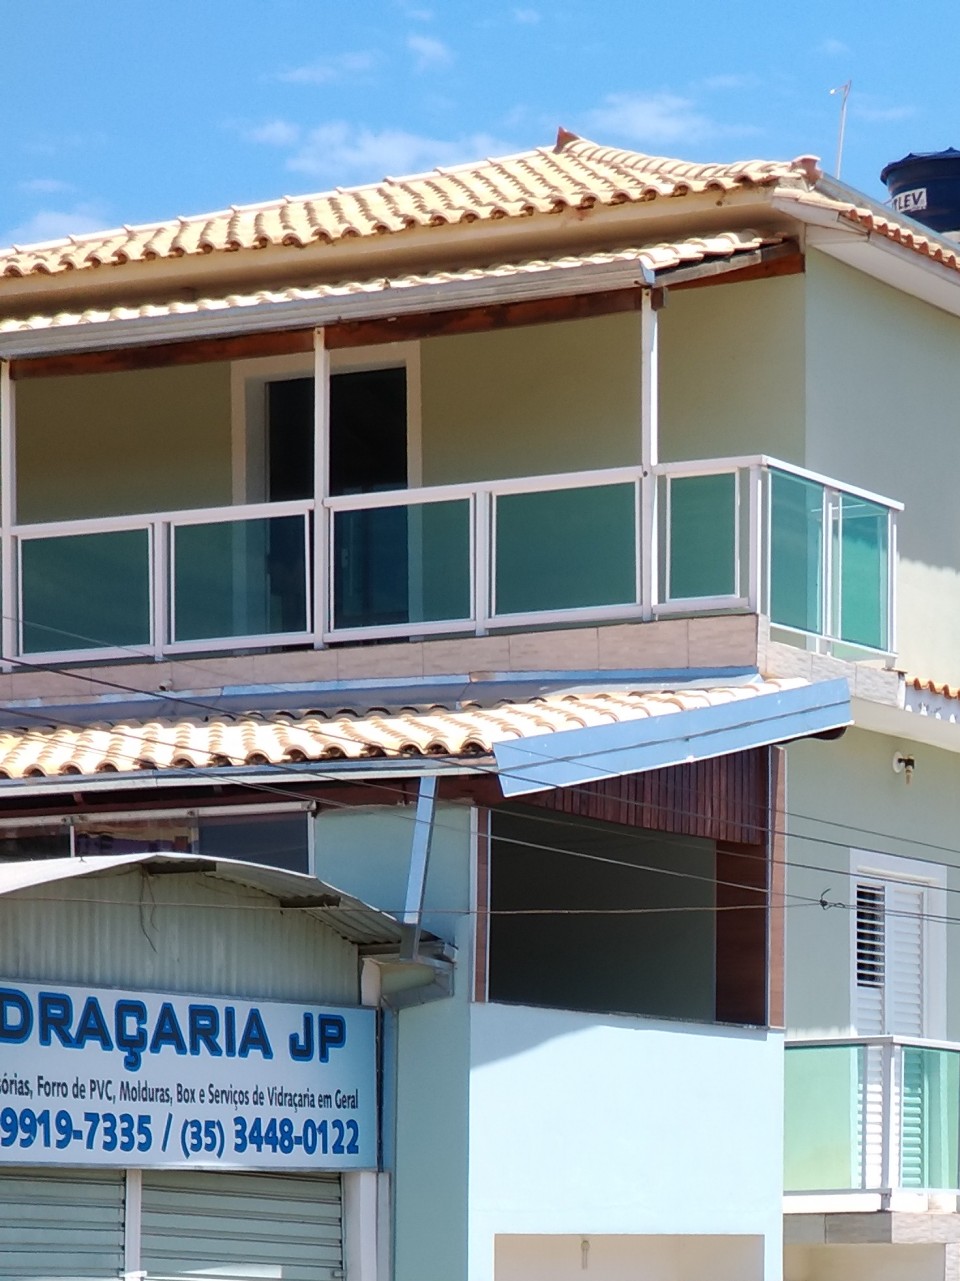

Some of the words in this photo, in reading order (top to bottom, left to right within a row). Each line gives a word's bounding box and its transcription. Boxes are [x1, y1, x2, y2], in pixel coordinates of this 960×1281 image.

[0, 988, 273, 1071] DRAÇARIA
[289, 1012, 346, 1063] JP
[0, 1073, 33, 1099] órias,
[37, 1075, 69, 1098] Forro
[72, 1077, 86, 1099] de
[90, 1079, 116, 1104] PVC,
[119, 1080, 173, 1106] Molduras,
[176, 1083, 195, 1104] Box
[199, 1091, 206, 1104] e
[208, 1084, 249, 1110] Serviços
[252, 1085, 264, 1106] de
[267, 1086, 316, 1113] Vidraçaria
[318, 1094, 332, 1109] em
[334, 1088, 359, 1110] Geral
[0, 1107, 153, 1152] 9919-7335
[161, 1112, 173, 1152] /
[180, 1118, 225, 1159] (35)
[233, 1116, 359, 1155] 3448-0122
